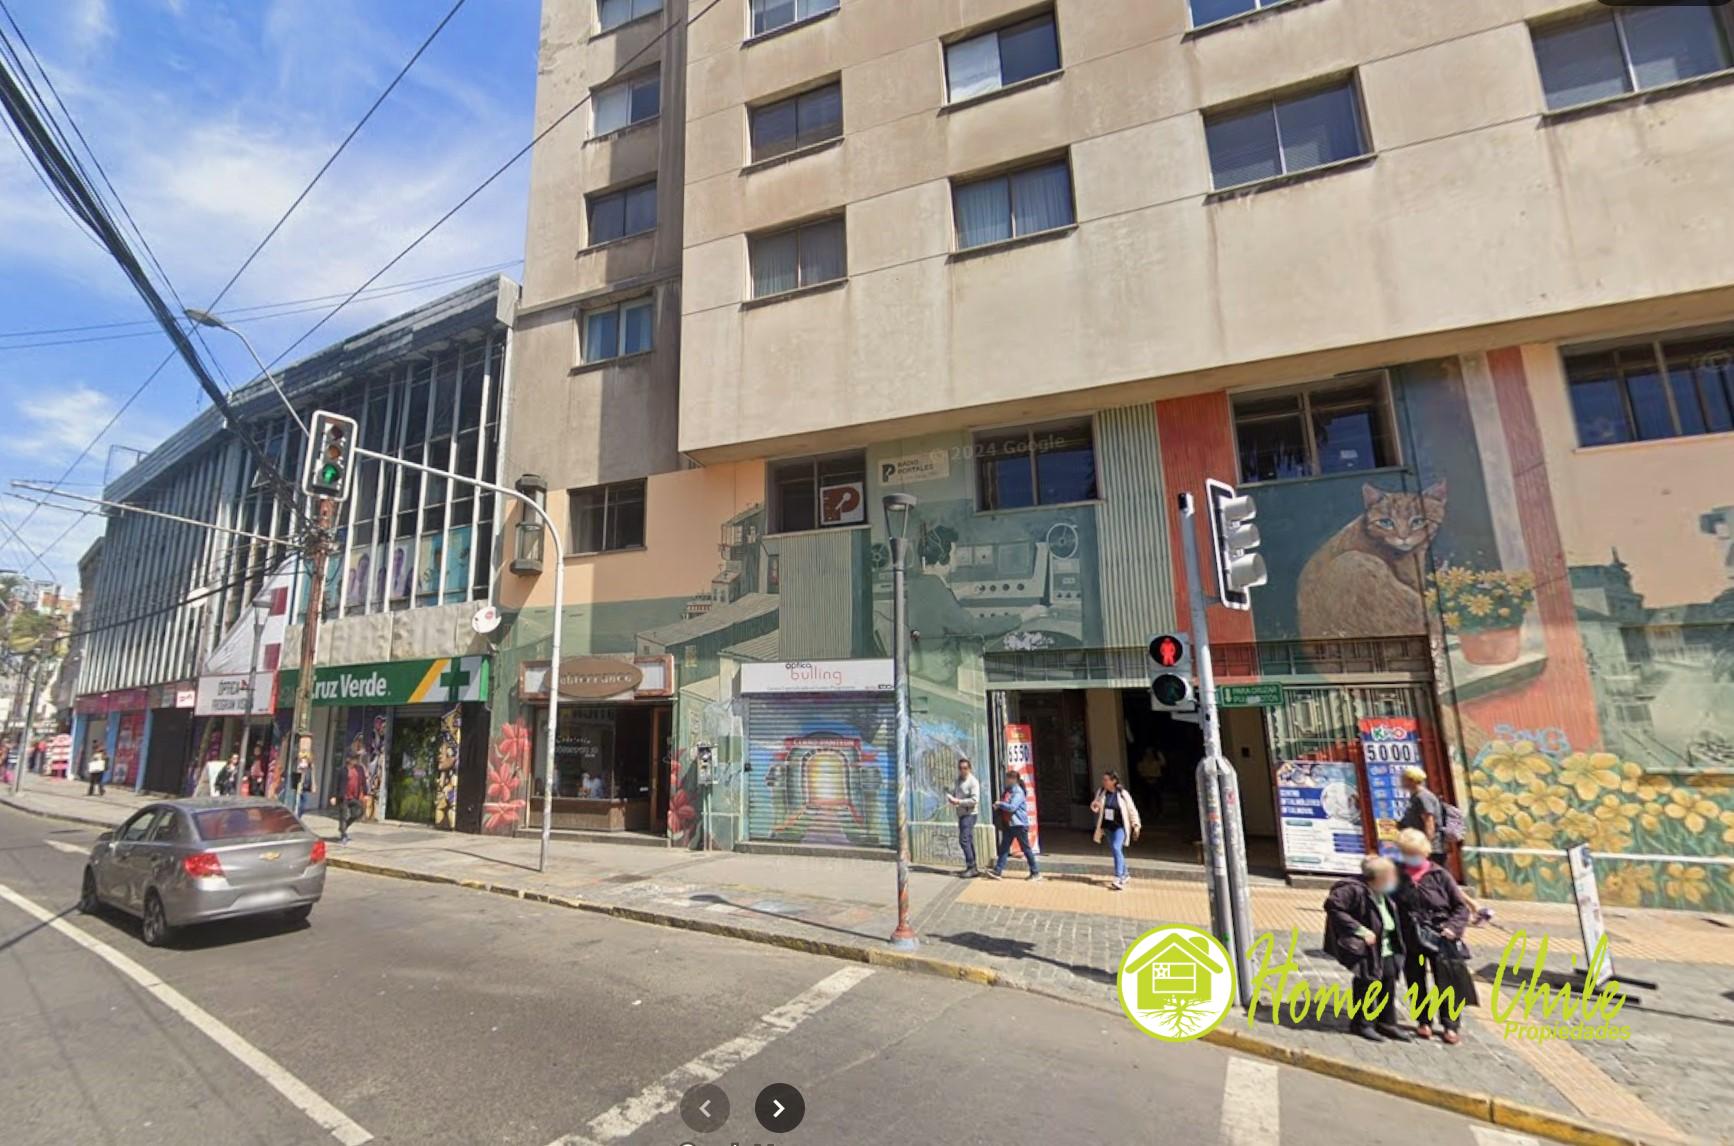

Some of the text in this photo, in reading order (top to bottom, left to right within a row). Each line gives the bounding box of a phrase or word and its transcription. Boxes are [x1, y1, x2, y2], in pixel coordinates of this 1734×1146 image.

[897, 464, 935, 475] PORTALES
[340, 671, 387, 698] Verde
[791, 666, 842, 685] bulling
[1366, 744, 1412, 761] 5000
